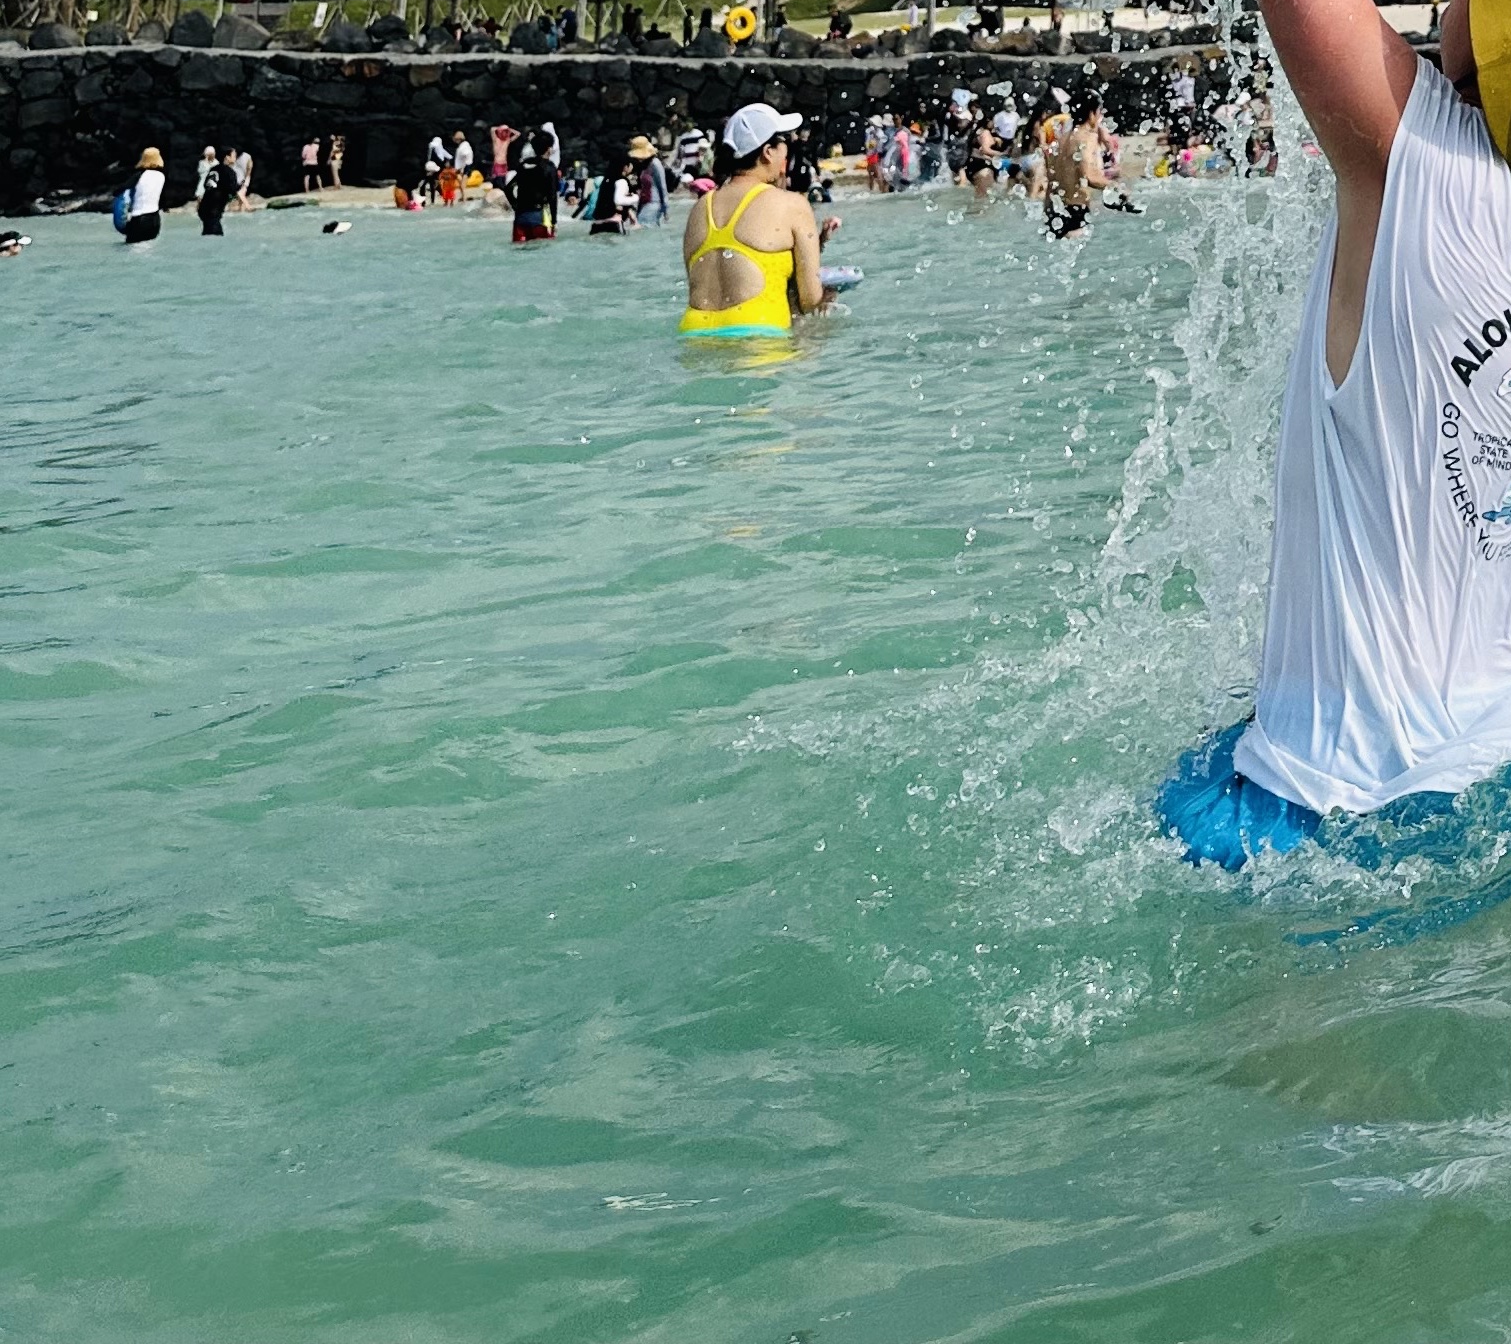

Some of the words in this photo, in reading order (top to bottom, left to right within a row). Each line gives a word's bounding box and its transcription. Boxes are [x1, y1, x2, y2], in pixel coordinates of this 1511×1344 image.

[1441, 402, 1461, 439] GO
[1480, 445, 1508, 458] STATE
[1472, 456, 1485, 464] OF
[1487, 458, 1511, 470] MIND
